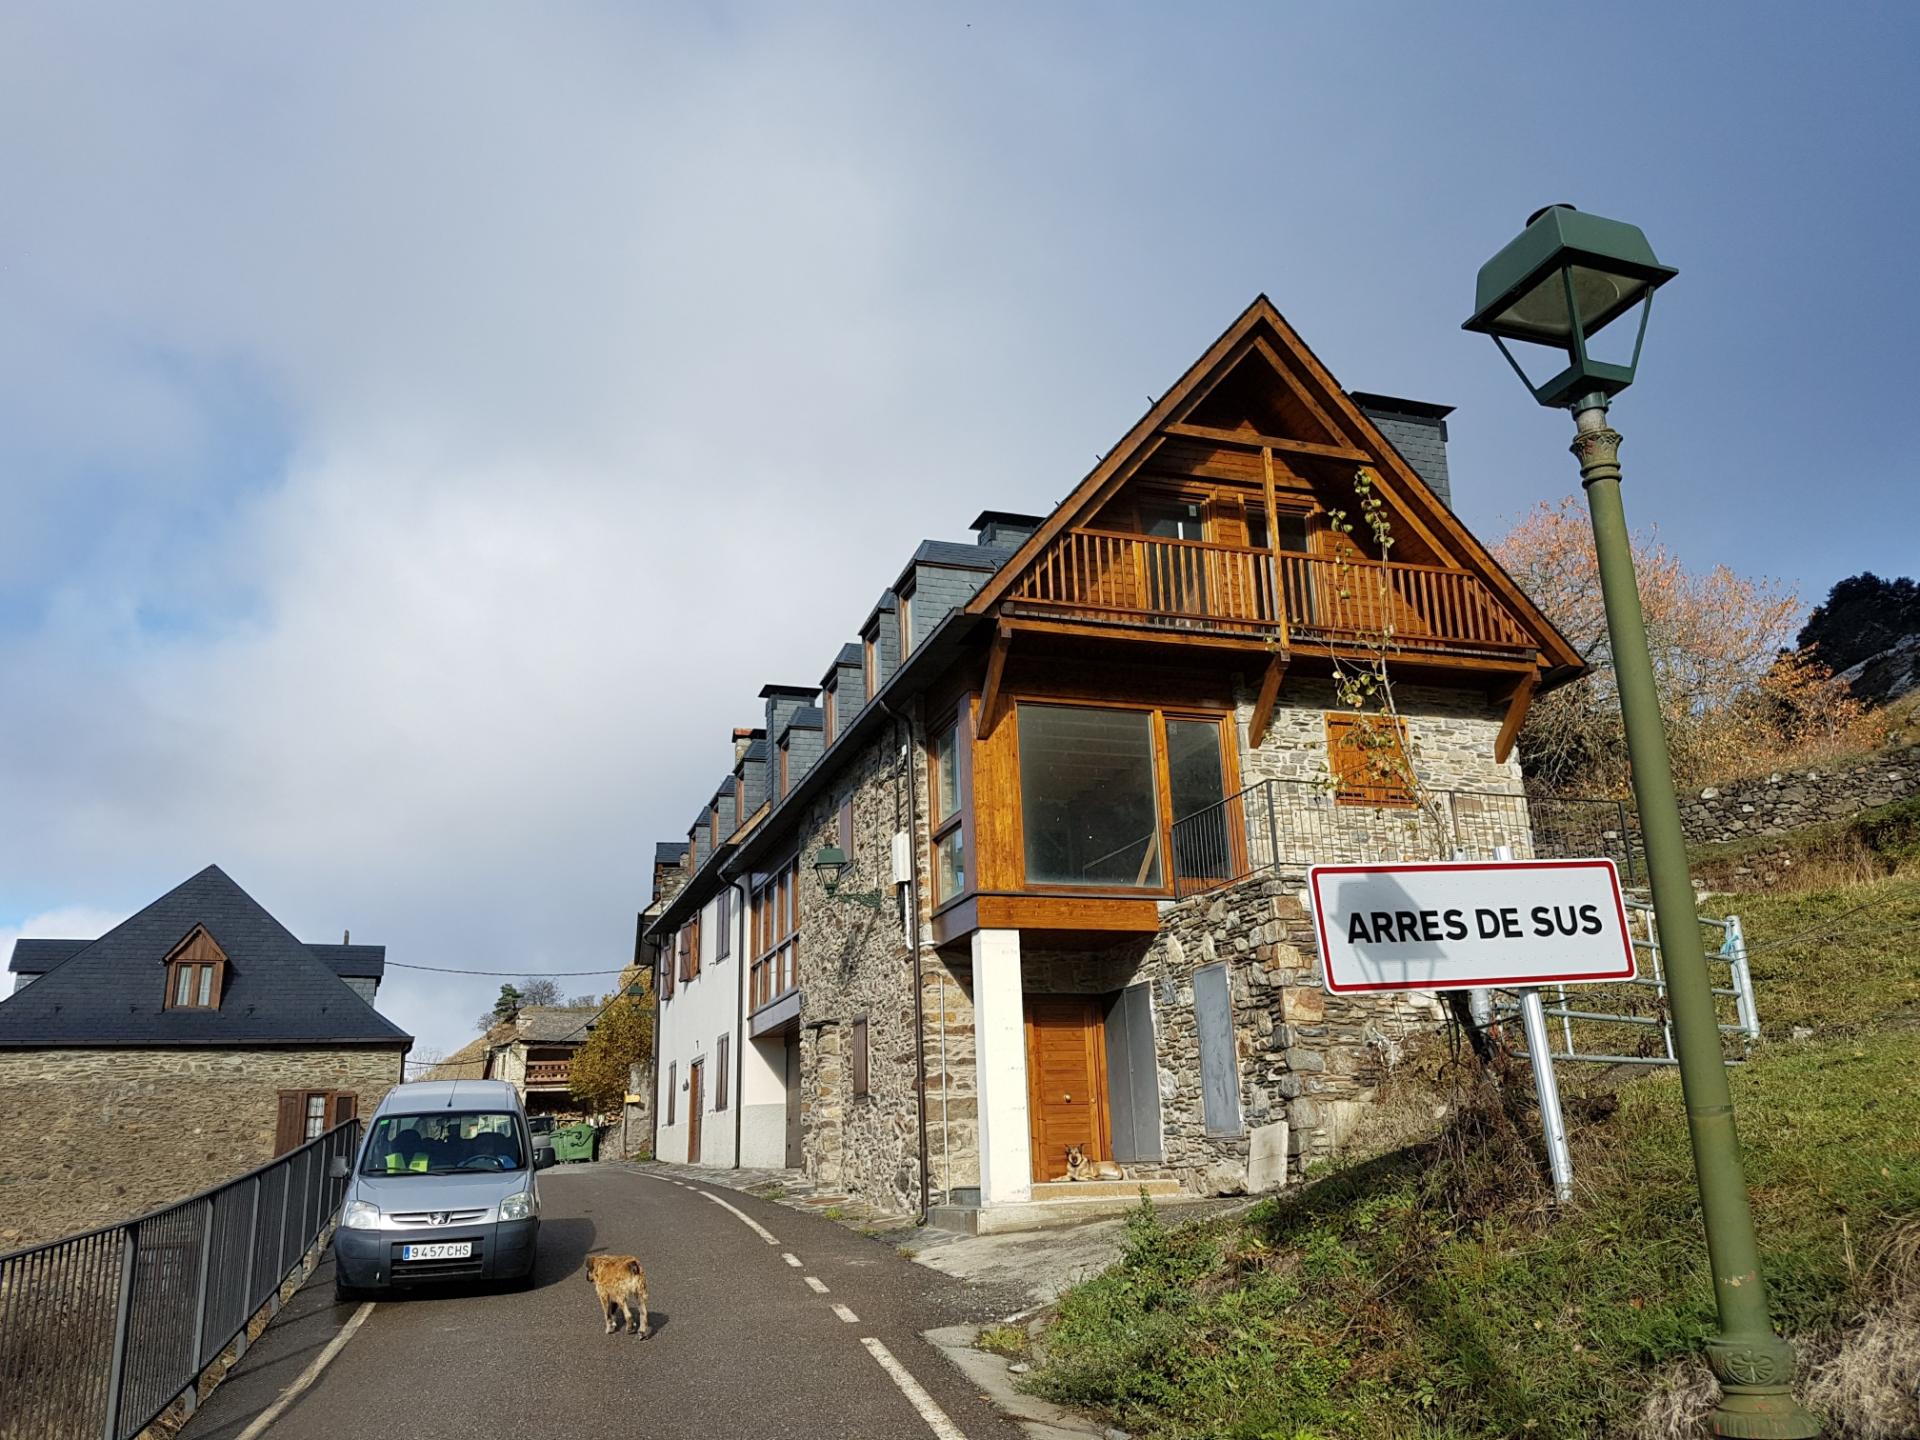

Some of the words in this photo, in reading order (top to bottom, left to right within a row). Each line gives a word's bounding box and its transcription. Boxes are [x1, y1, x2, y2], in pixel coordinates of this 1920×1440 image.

[1347, 909, 1469, 944] ARRES
[1475, 908, 1524, 939] DE
[1531, 904, 1603, 937] SUS
[411, 1245, 445, 1258] 9457
[446, 1244, 469, 1257] CHS
